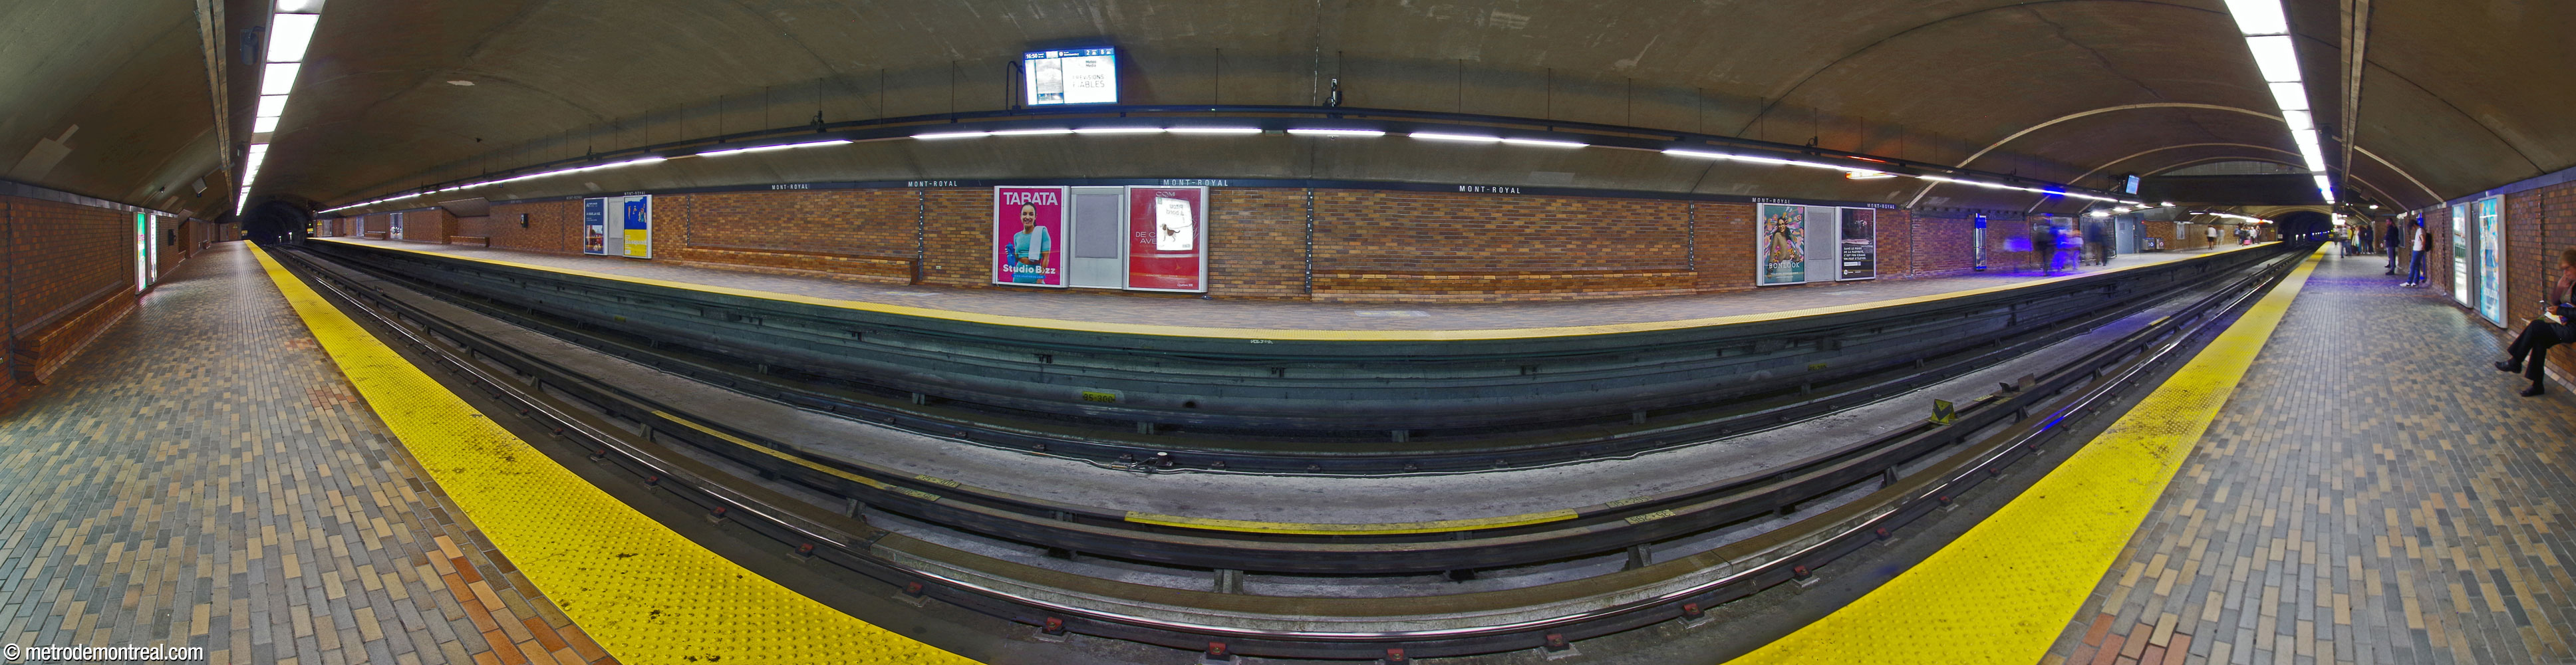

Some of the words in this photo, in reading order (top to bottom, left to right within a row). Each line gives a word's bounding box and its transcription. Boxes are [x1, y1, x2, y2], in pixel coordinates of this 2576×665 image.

[1459, 185, 1520, 194] MONT-ROYAL
[1003, 192, 1058, 205] TABATA
[1003, 264, 1034, 273] Studio
